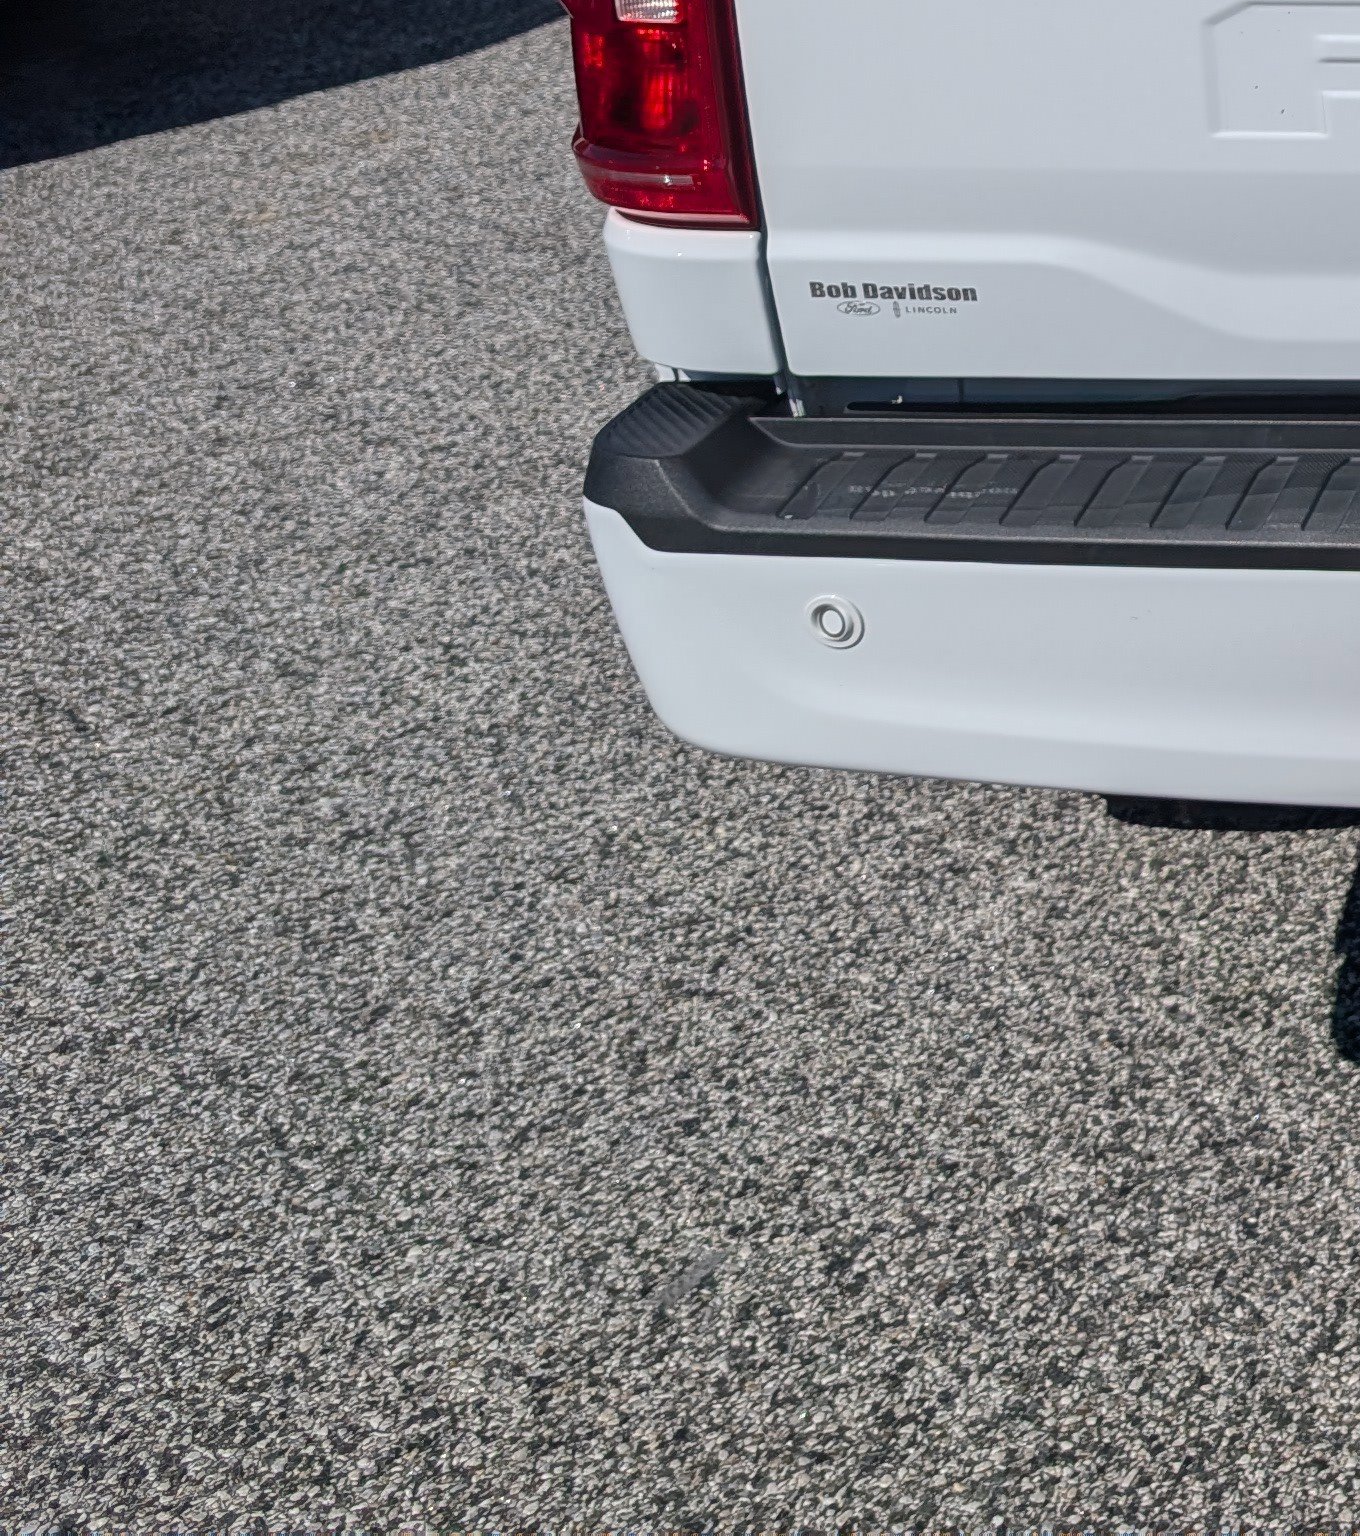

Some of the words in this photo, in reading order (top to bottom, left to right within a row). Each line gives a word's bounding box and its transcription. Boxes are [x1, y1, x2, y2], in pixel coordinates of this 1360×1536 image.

[809, 281, 857, 298] Bob
[862, 282, 978, 302] Davidson
[844, 301, 873, 315] Ford
[905, 305, 957, 314] LINCOLN
